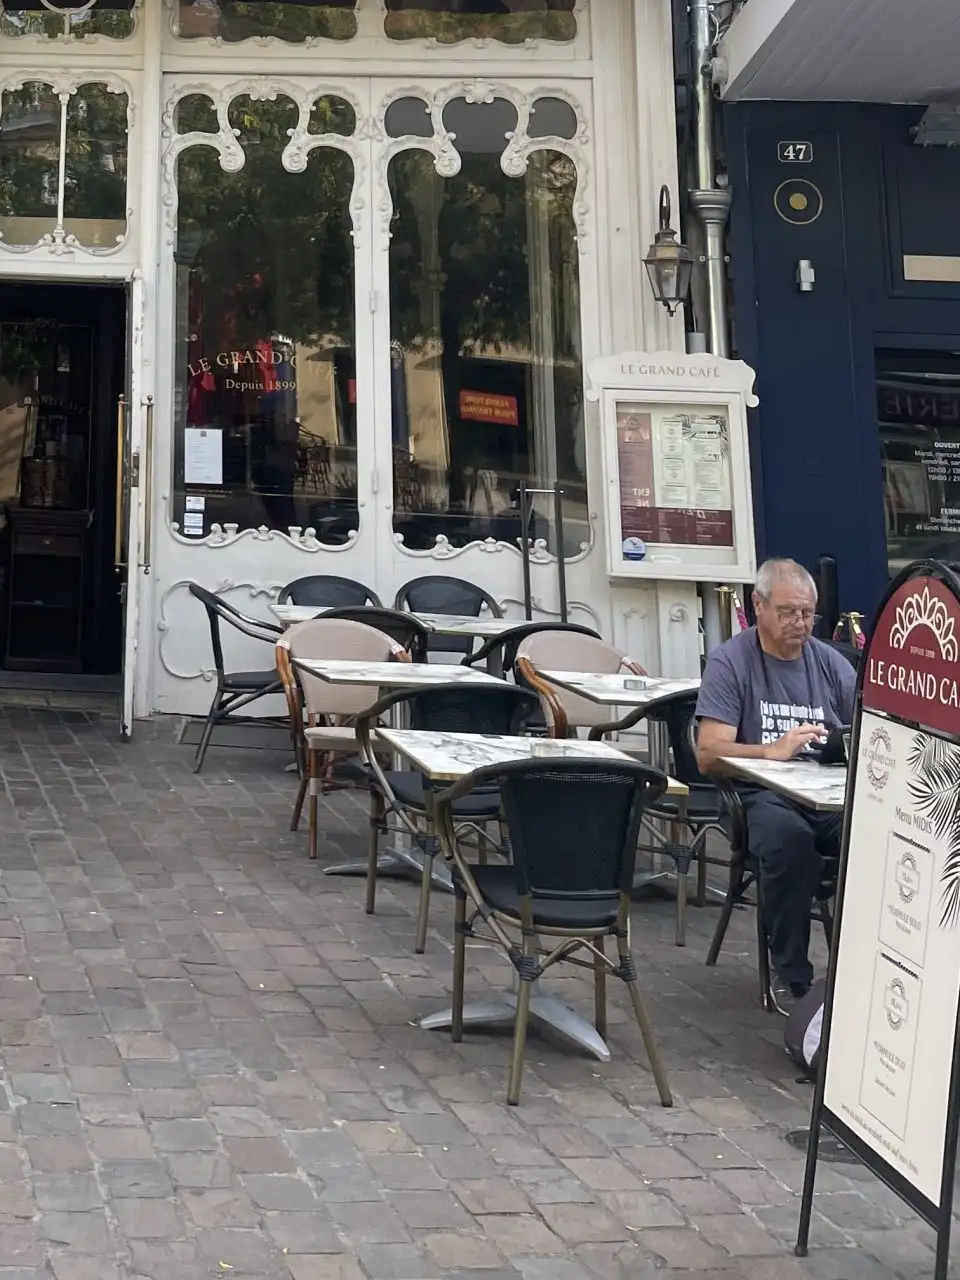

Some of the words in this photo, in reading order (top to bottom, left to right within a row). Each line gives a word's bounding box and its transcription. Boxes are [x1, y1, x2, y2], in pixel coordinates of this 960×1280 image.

[783, 143, 807, 160] 47
[188, 357, 212, 377] LE
[216, 350, 282, 367] GRAND
[620, 364, 635, 375] LE
[638, 364, 686, 376] GRAND
[688, 366, 722, 378] CAFÉ
[226, 379, 264, 393] Depuis
[269, 379, 297, 391] 1899
[870, 658, 885, 686] LE
[887, 663, 937, 700] GRAND
[939, 677, 960, 708] CA
[895, 805, 912, 825] Menu
